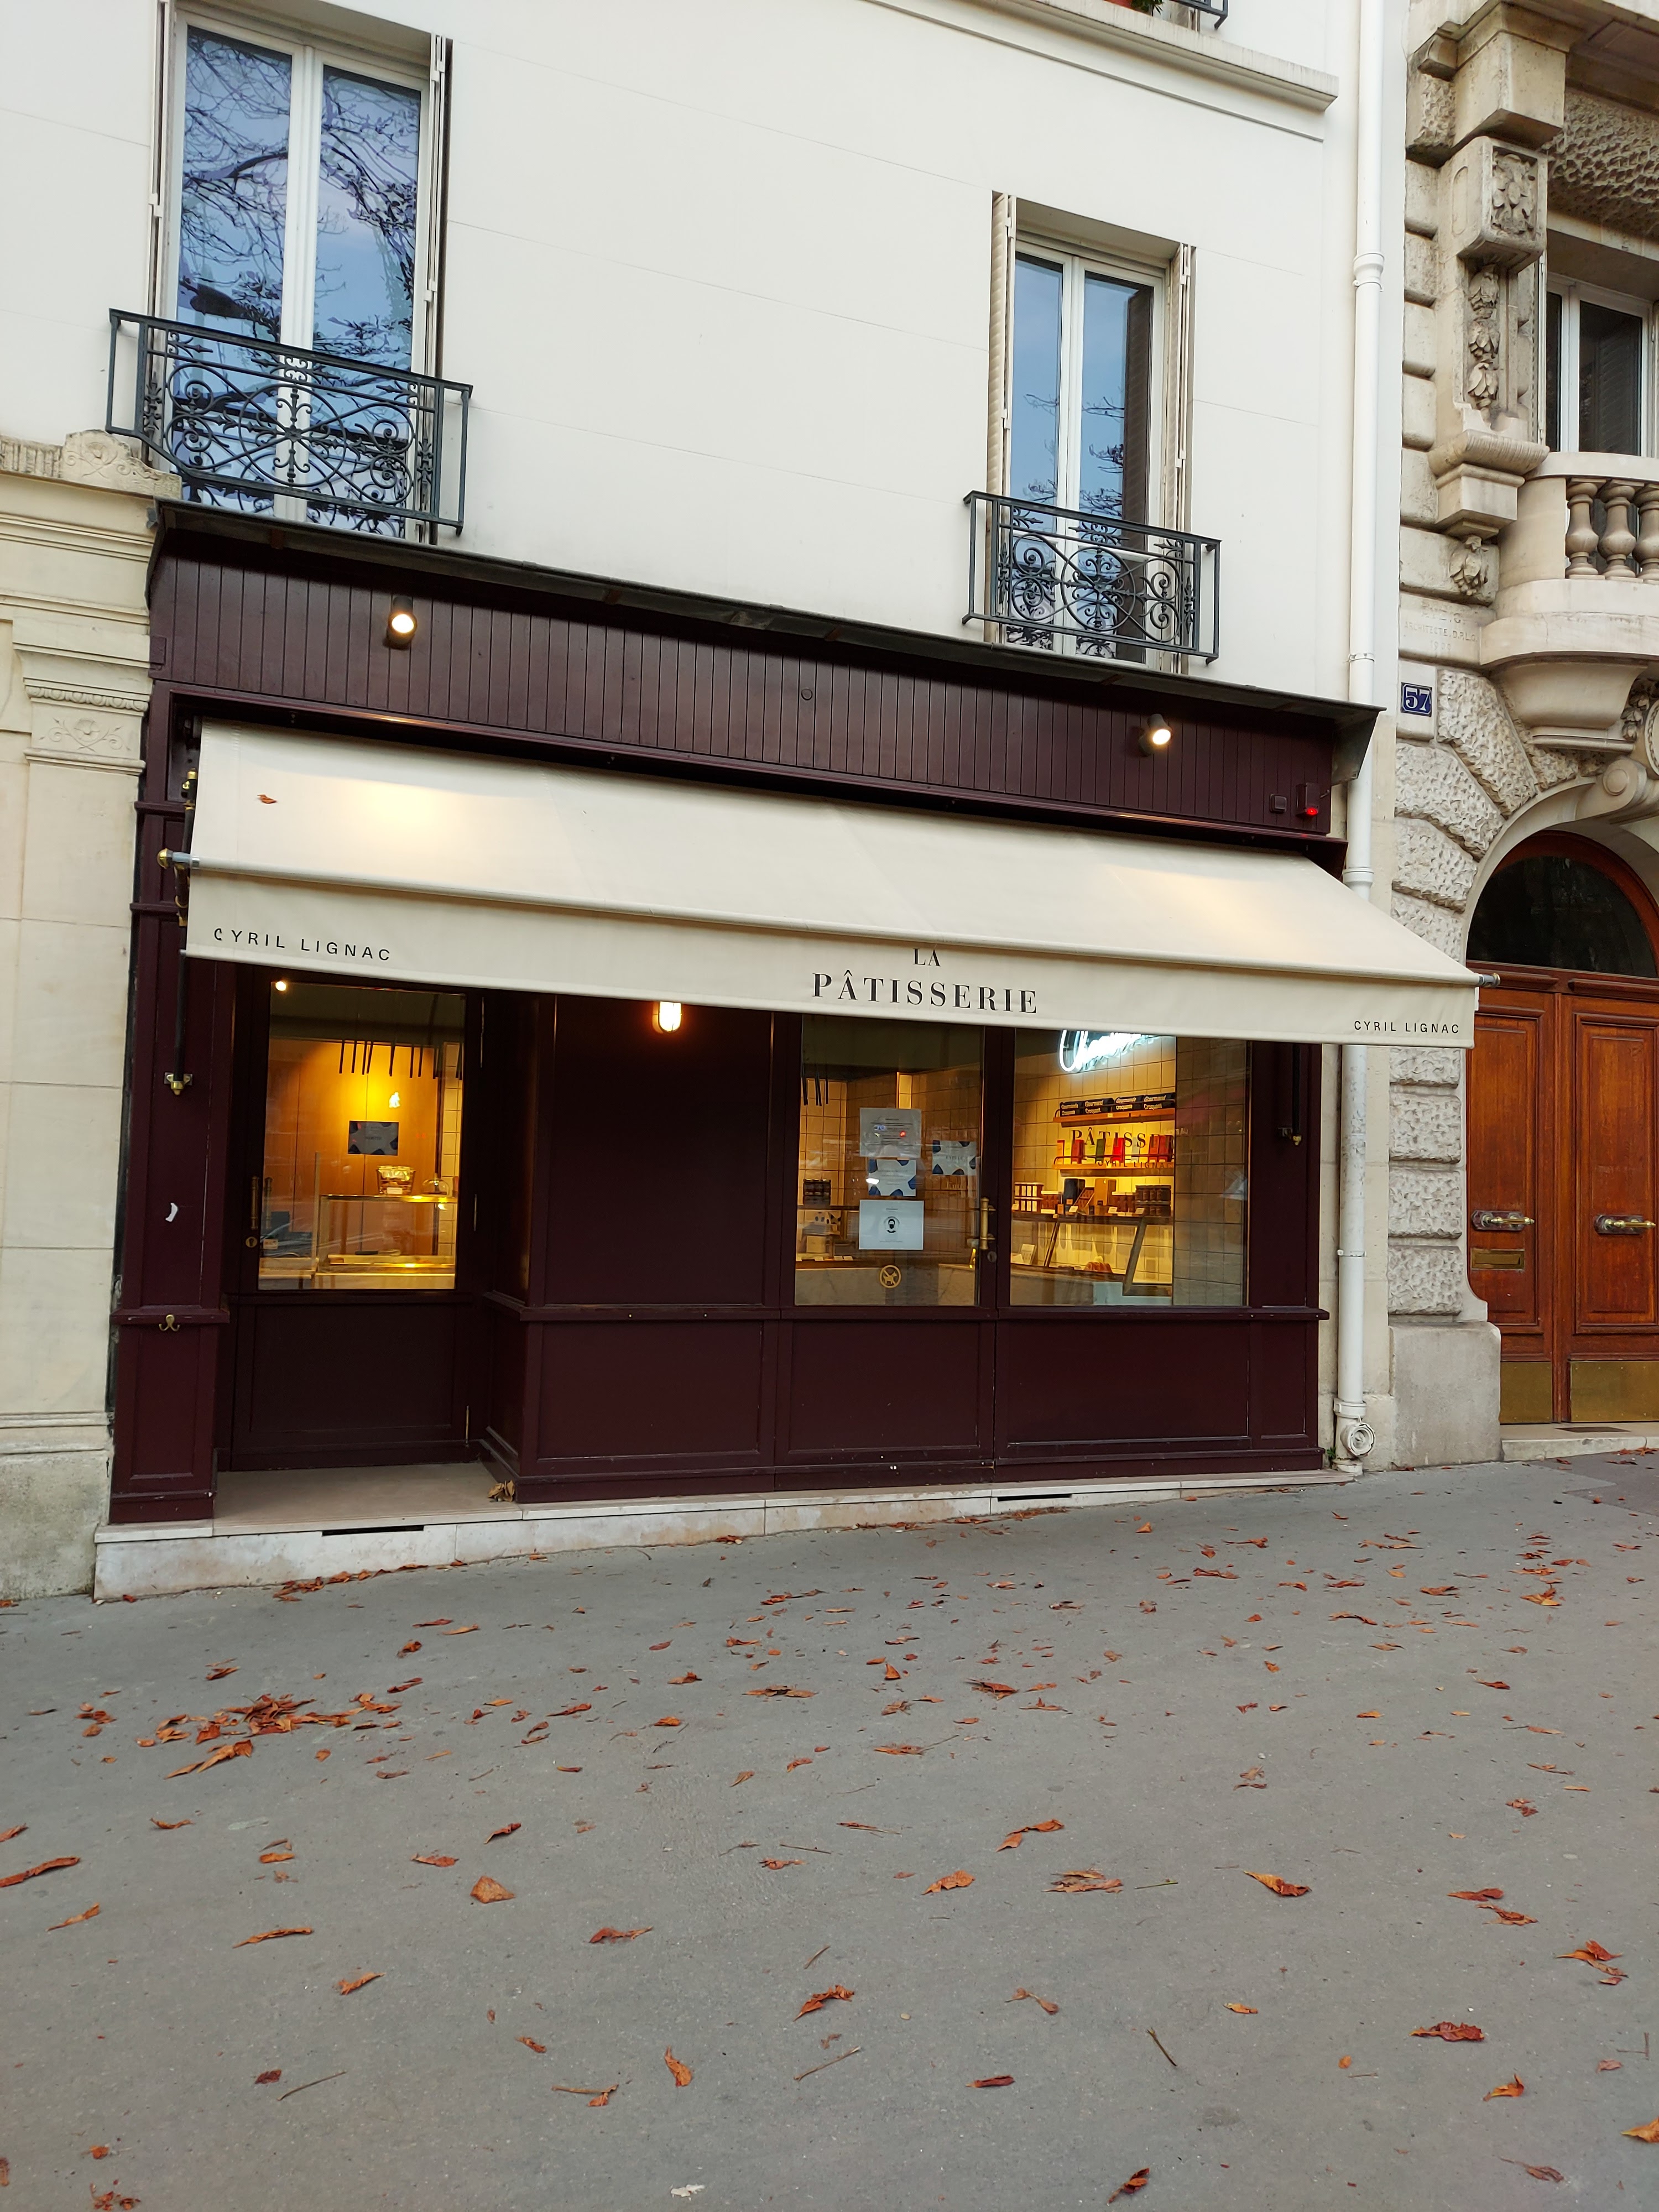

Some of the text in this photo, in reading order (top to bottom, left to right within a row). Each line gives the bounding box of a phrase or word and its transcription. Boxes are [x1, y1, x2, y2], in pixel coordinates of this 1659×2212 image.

[1405, 687, 1431, 711] 57
[214, 928, 390, 961] CYRIL LIGNAC
[912, 948, 941, 967] LA
[812, 969, 1037, 1014] PÂTISSERIE
[1354, 1020, 1459, 1034] CYRIL LIGNAC
